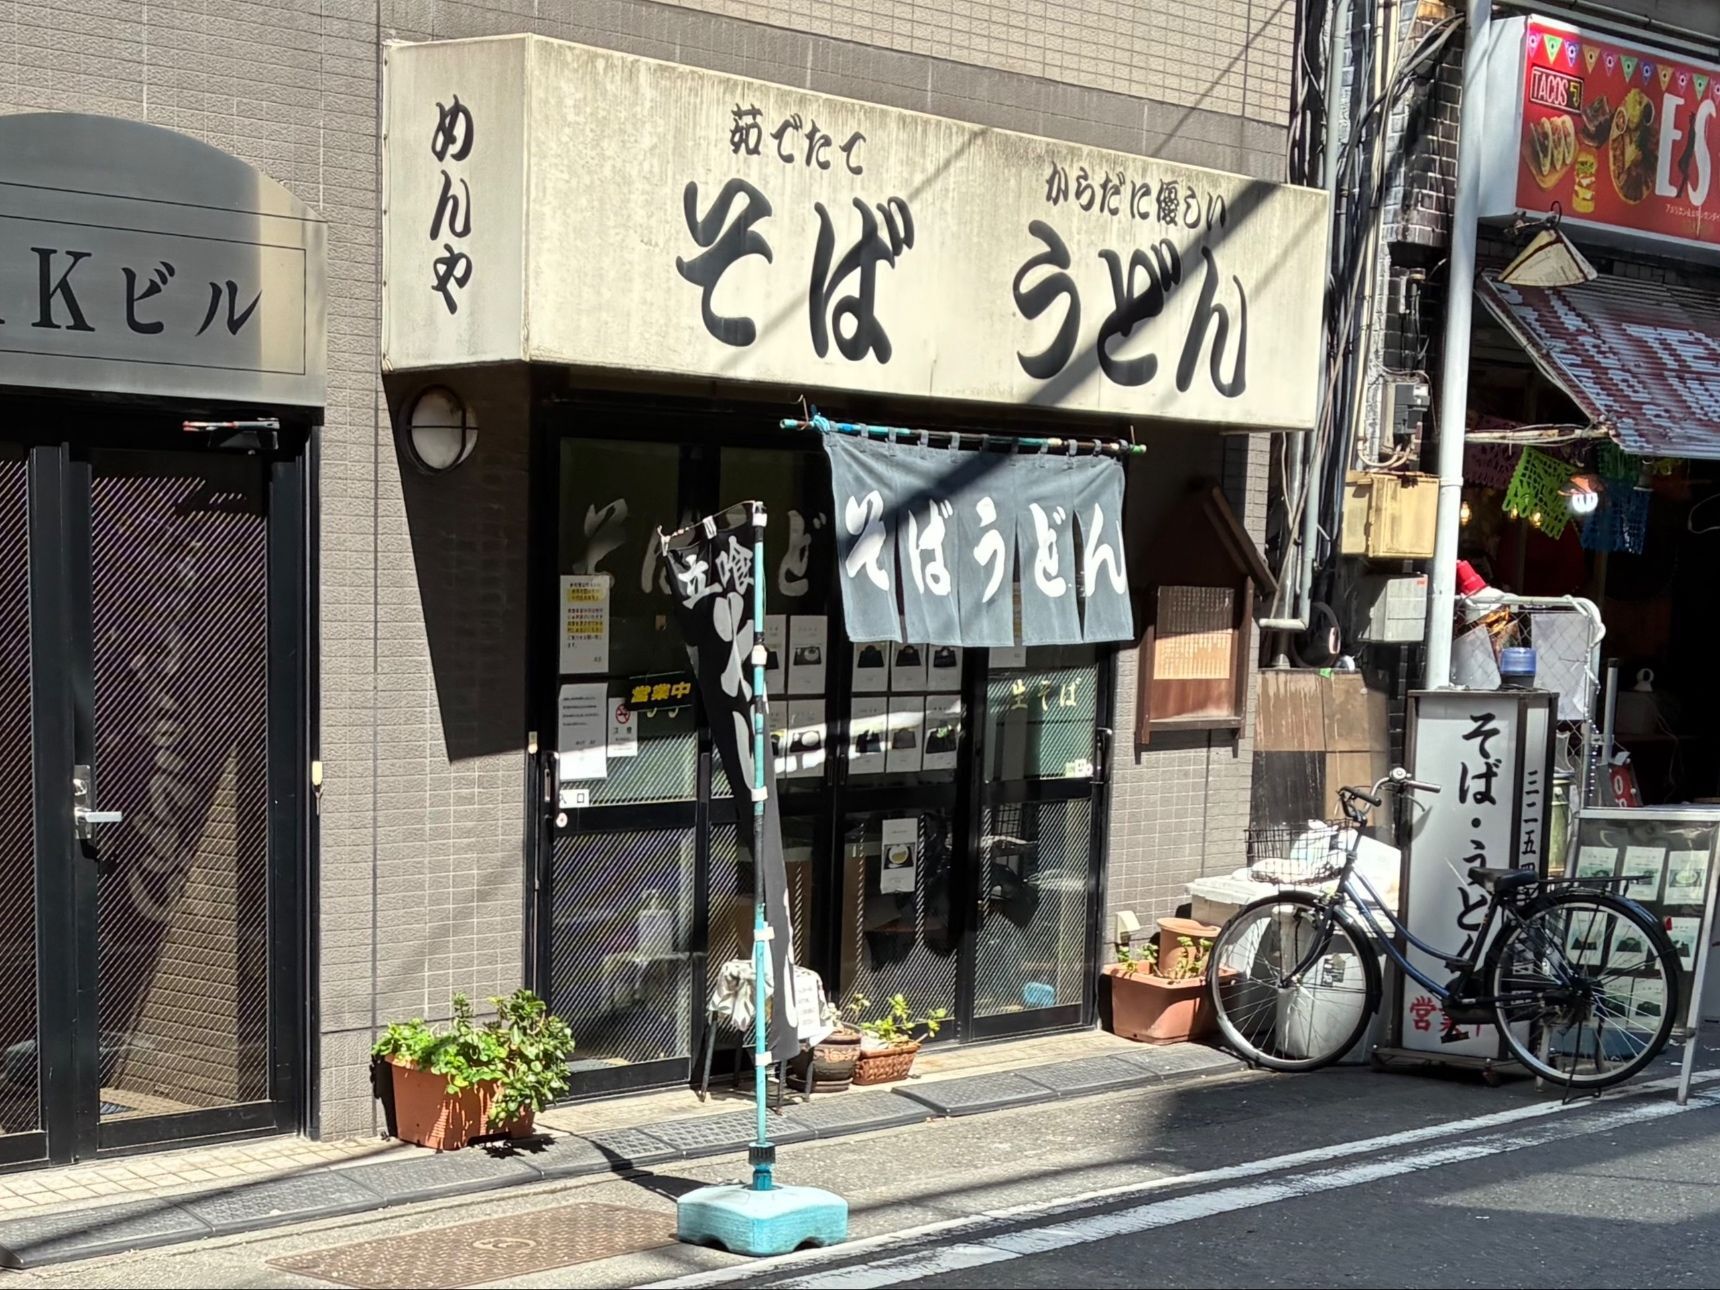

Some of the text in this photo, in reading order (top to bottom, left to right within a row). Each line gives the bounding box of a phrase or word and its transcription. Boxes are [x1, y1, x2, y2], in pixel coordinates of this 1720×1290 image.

[1533, 70, 1569, 106] TACOS
[731, 103, 868, 175] 茹でたて
[429, 93, 474, 316] めんや
[1045, 160, 1228, 229] からだに優しい
[0, 247, 262, 337] Kビル
[675, 177, 1248, 398] そば うどん
[844, 489, 1127, 603] そばうどん
[630, 680, 691, 703] 営業中
[1010, 676, 1082, 712] 生そば
